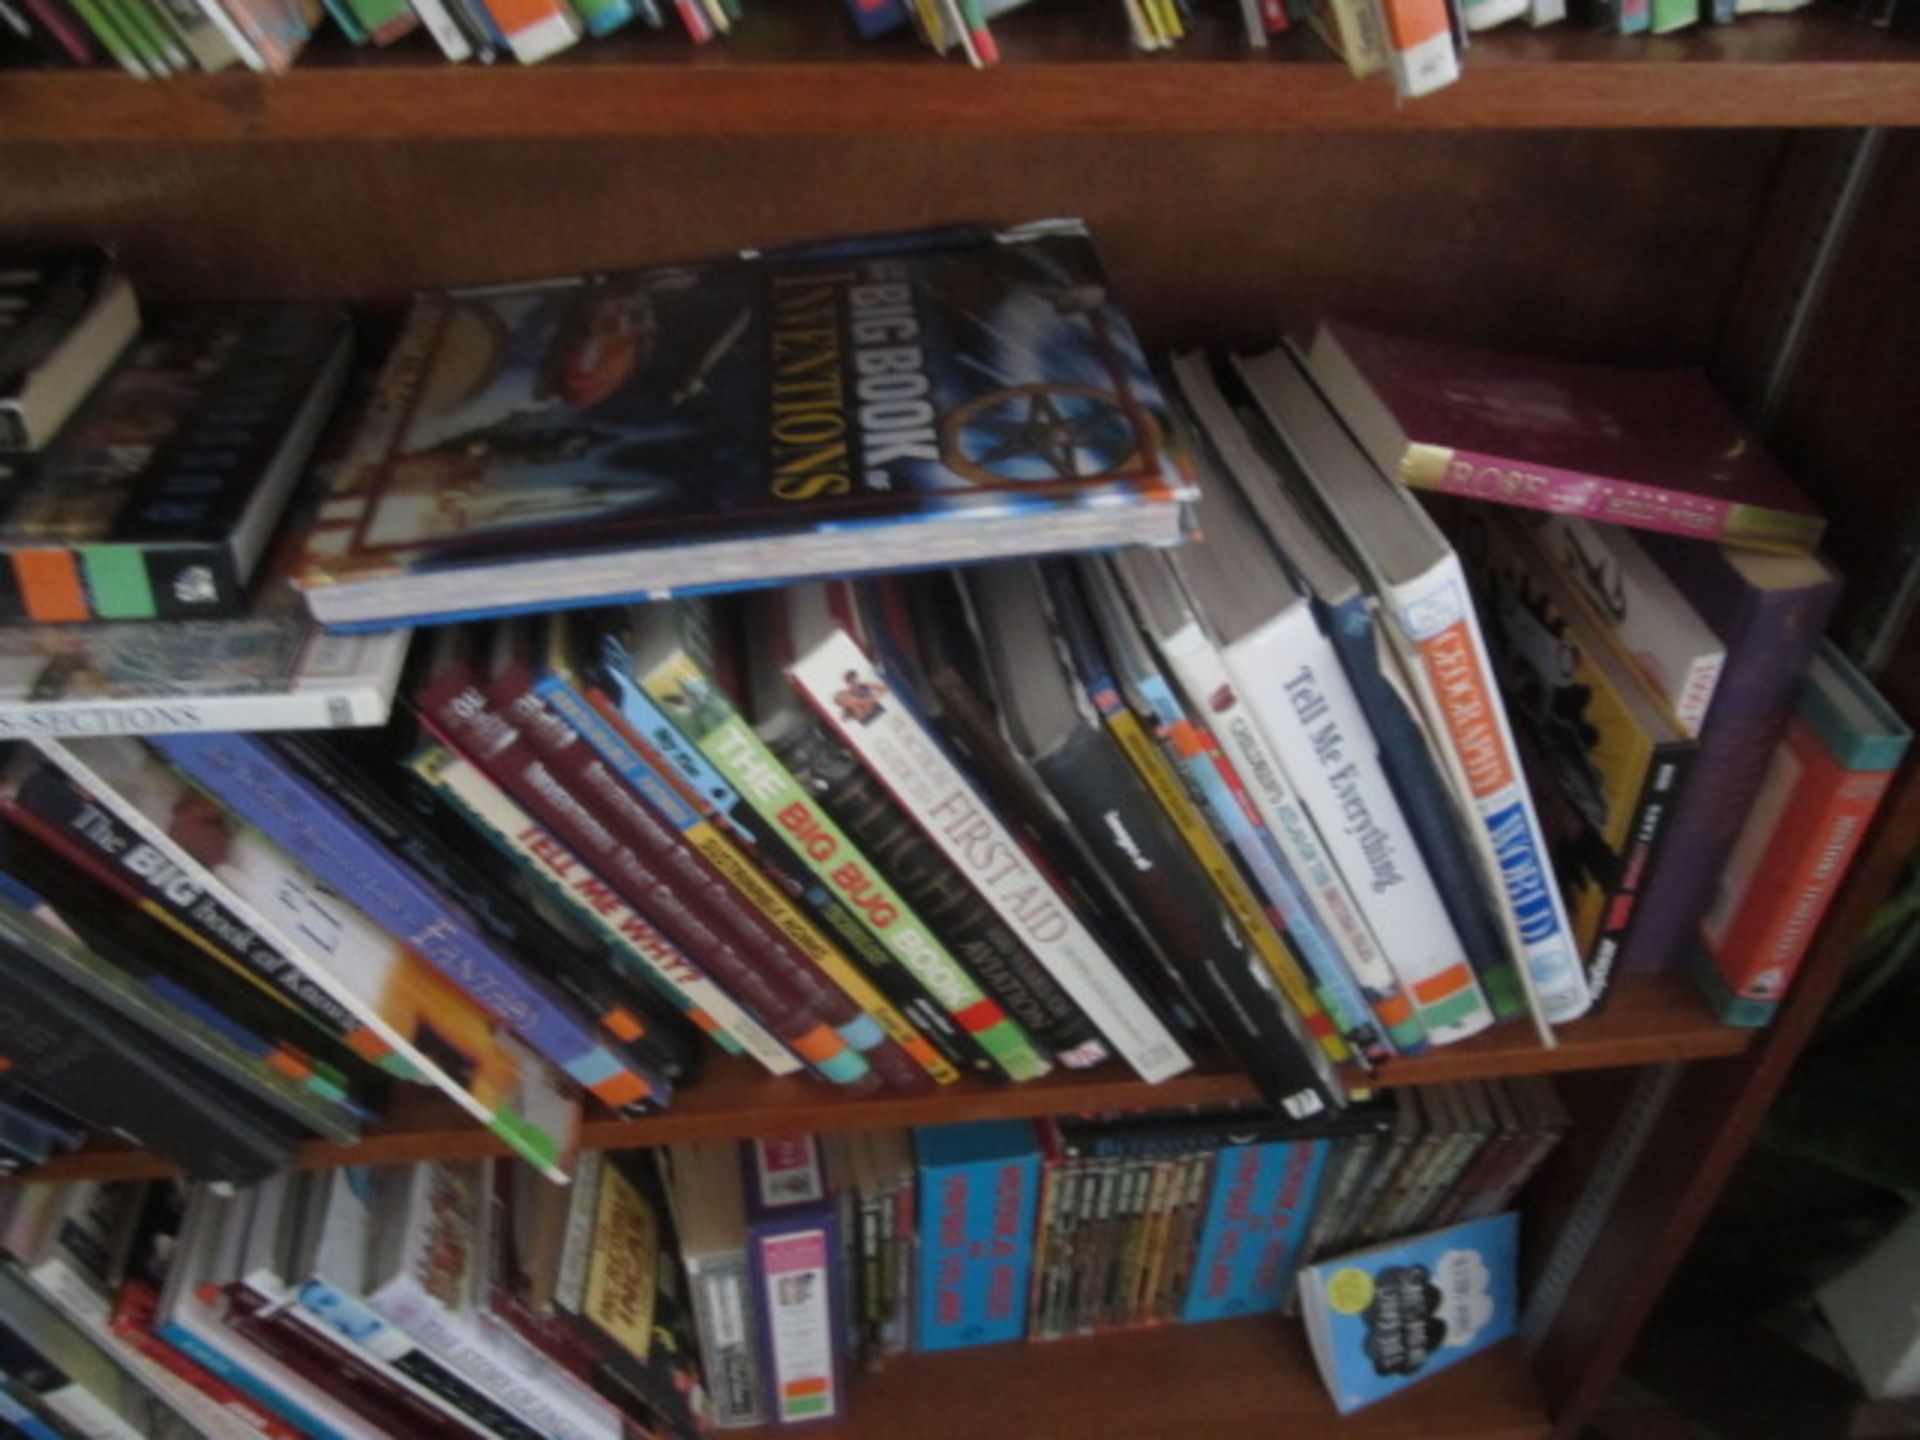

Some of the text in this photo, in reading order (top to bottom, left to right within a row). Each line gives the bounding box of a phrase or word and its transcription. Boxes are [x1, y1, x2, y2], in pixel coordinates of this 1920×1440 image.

[769, 271, 853, 499] INVENTIONS
[851, 283, 921, 344] BIG
[855, 346, 940, 463] BOOK
[1282, 665, 1404, 894] Tell Me Everything
[1423, 630, 1504, 793] GEOGRAPHY
[70, 805, 122, 856] The
[122, 837, 204, 902] BIG
[517, 826, 579, 877] TELL
[576, 876, 619, 917] ME
[615, 915, 703, 984] WHY?
[714, 725, 788, 799] THE
[775, 799, 838, 862] BIG
[830, 860, 898, 930] BUG
[890, 927, 973, 1010] BOOK
[838, 785, 983, 934] FLIGHT
[928, 789, 1071, 945] FIRST AID
[1488, 806, 1558, 942] WORLD
